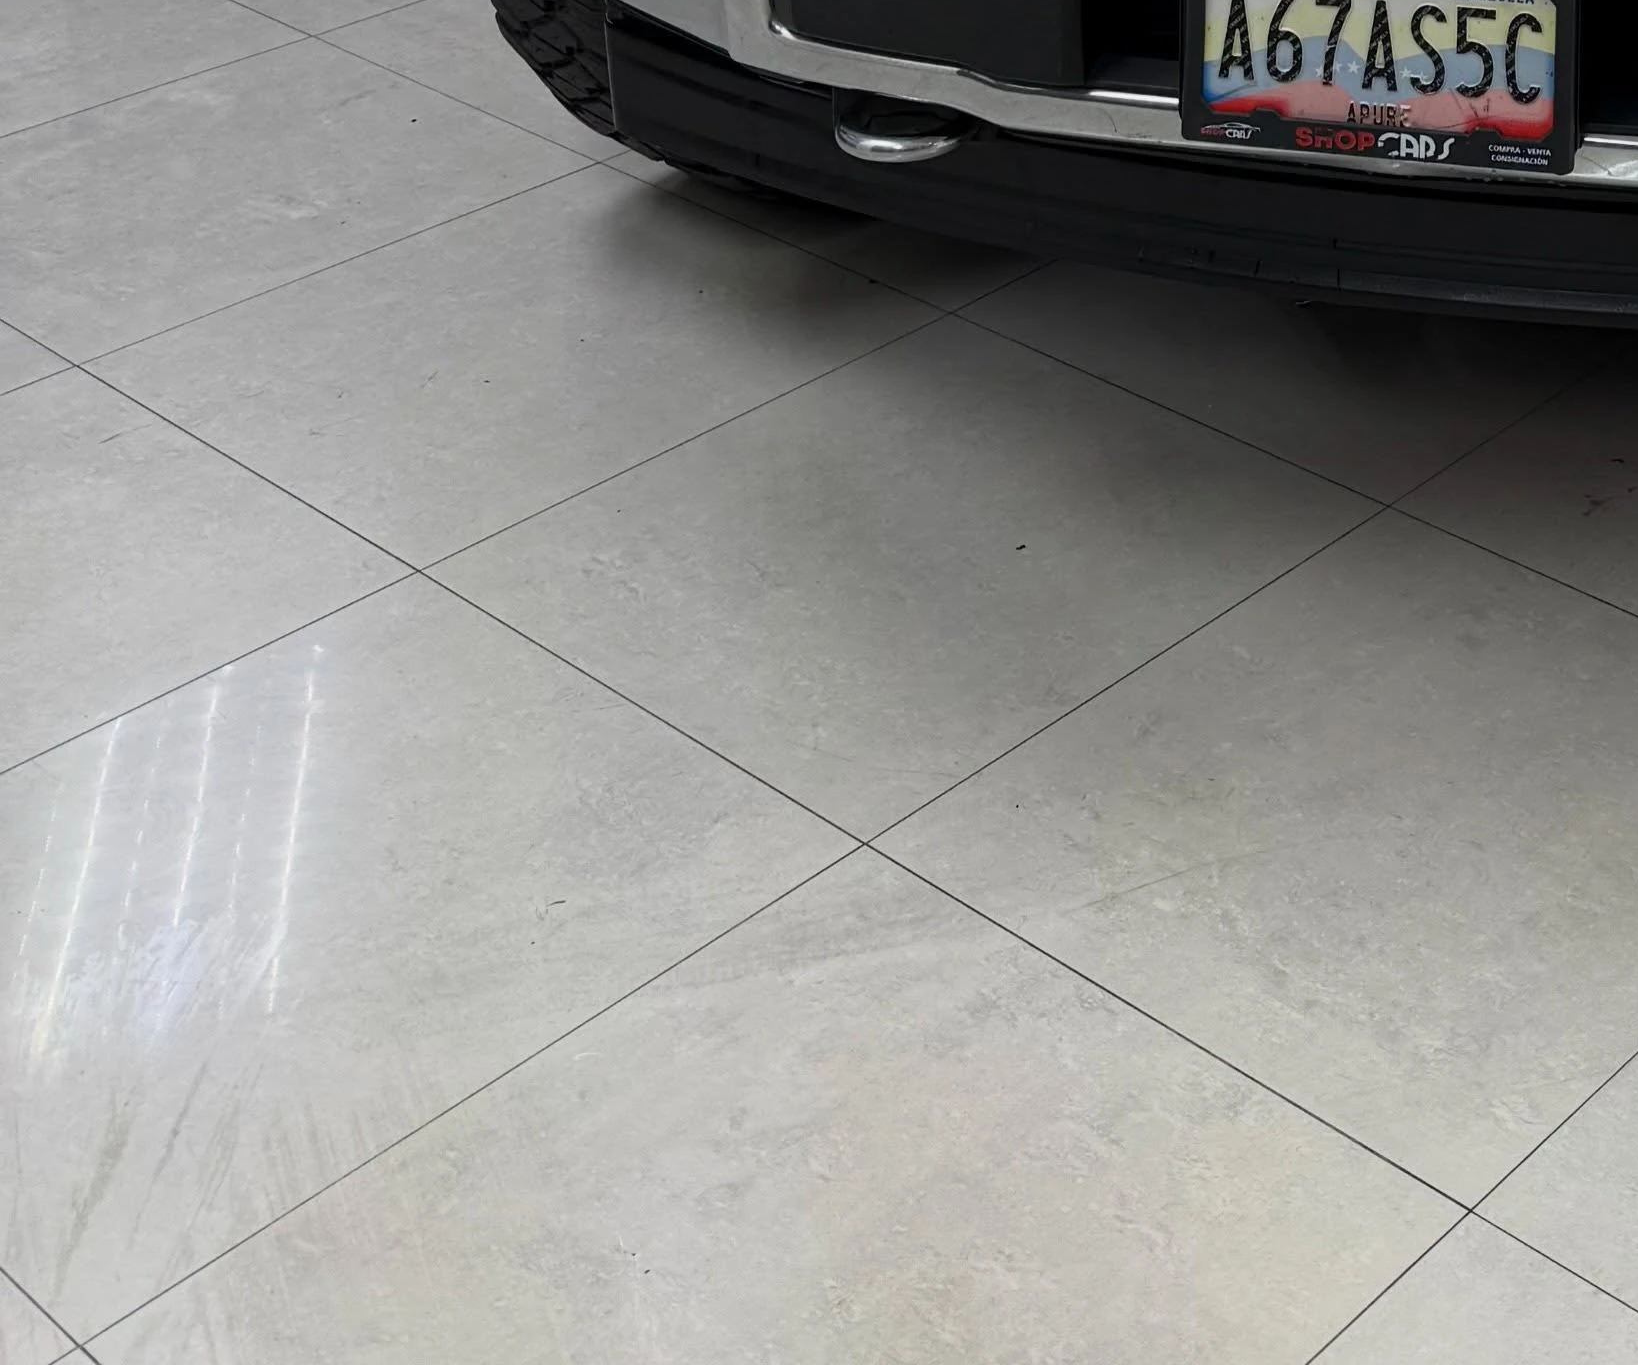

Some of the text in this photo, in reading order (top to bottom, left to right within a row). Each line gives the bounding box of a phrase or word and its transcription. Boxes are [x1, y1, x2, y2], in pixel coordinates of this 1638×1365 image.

[1346, 101, 1412, 127] APURE
[1488, 143, 1521, 154] COMPRA
[1527, 147, 1552, 157] VENTA
